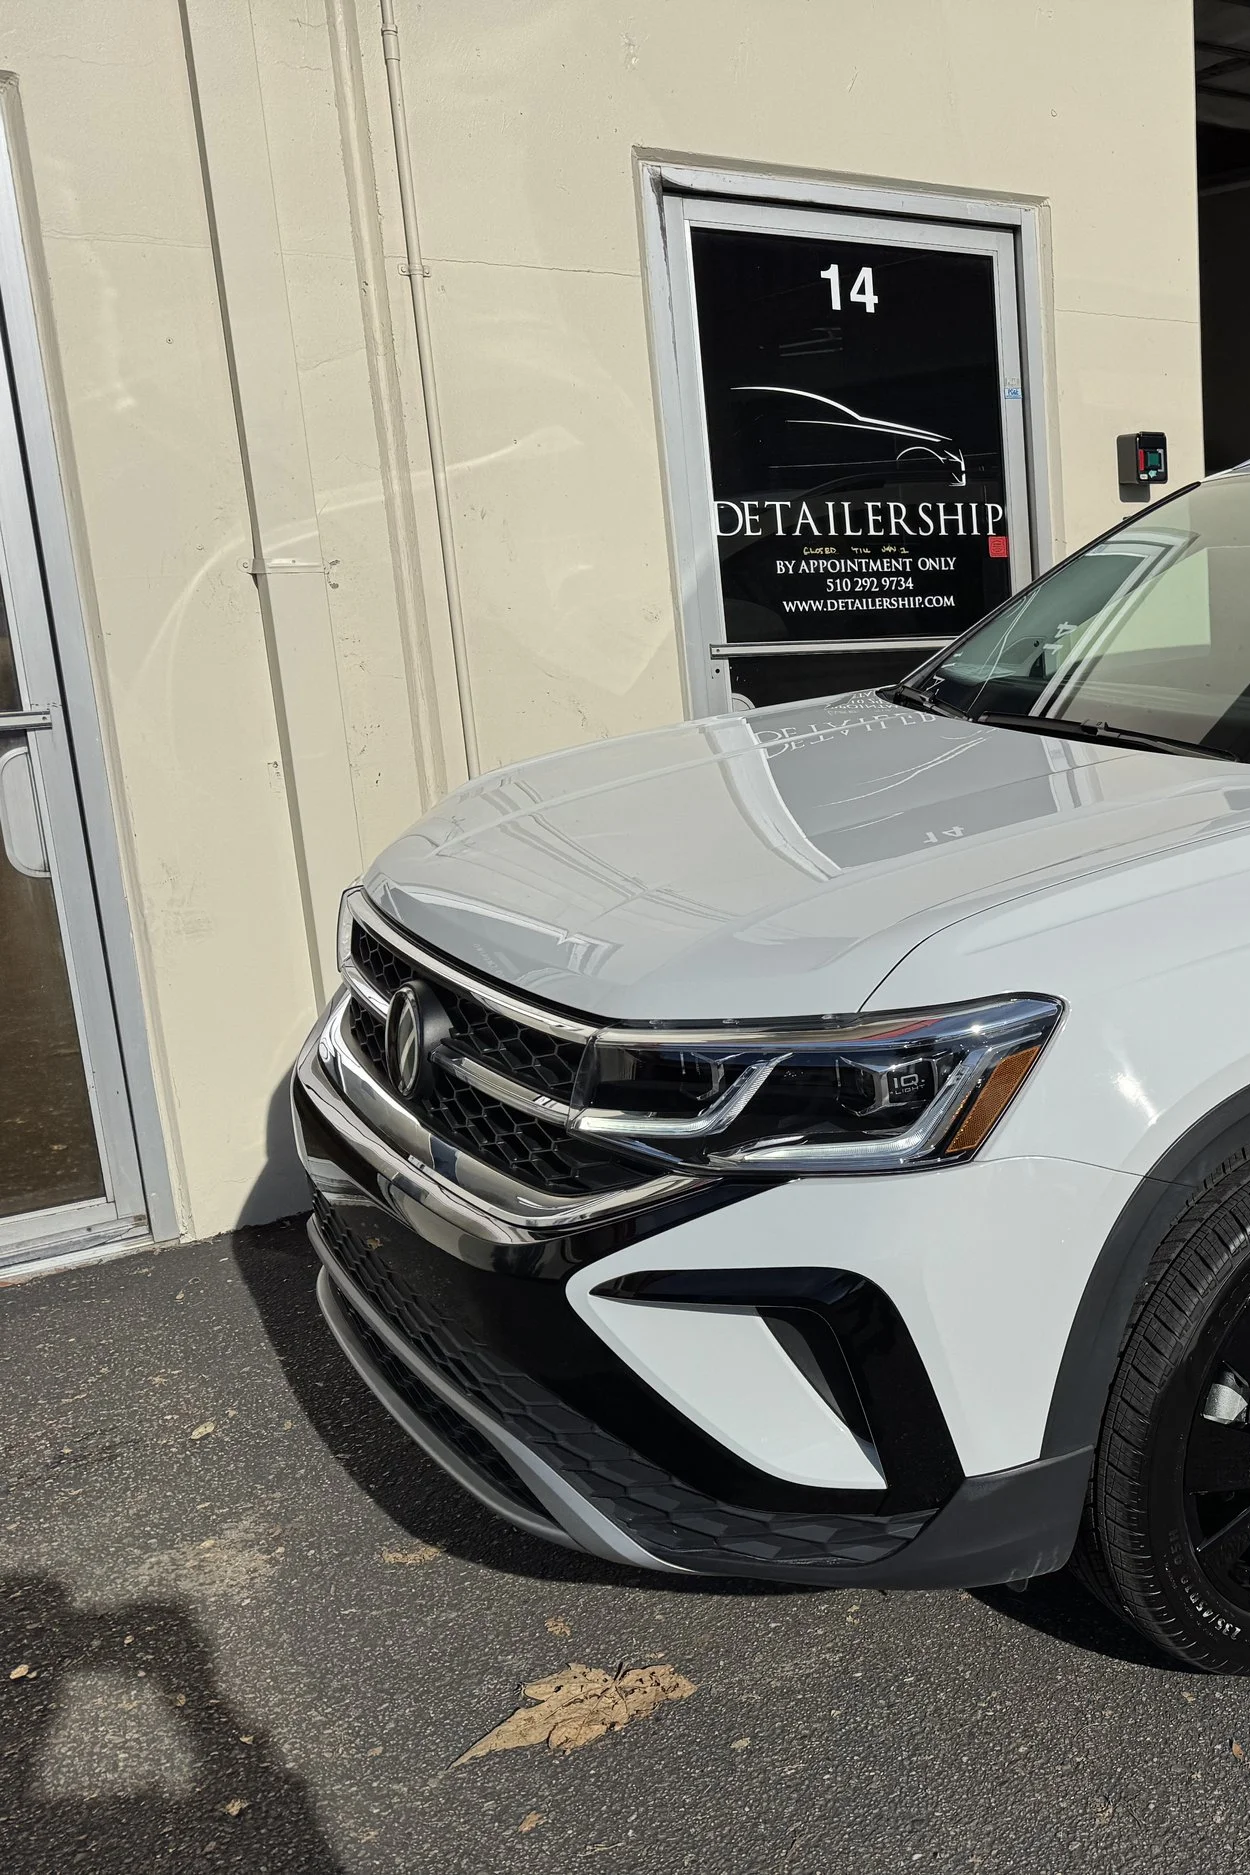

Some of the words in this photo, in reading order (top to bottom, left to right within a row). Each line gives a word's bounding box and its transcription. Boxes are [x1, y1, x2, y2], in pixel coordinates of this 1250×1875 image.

[820, 264, 878, 313] 14
[713, 501, 1003, 536] DETAILERSHIP
[803, 546, 837, 555] CLOSED
[776, 560, 796, 574] BY
[798, 558, 912, 573] APPOINTMENT
[917, 557, 956, 571] ONLY
[826, 578, 850, 592] 510
[854, 577, 879, 592] 292
[881, 577, 914, 591] 9734
[783, 596, 956, 612] WWW.DETAILERSHIP.COM
